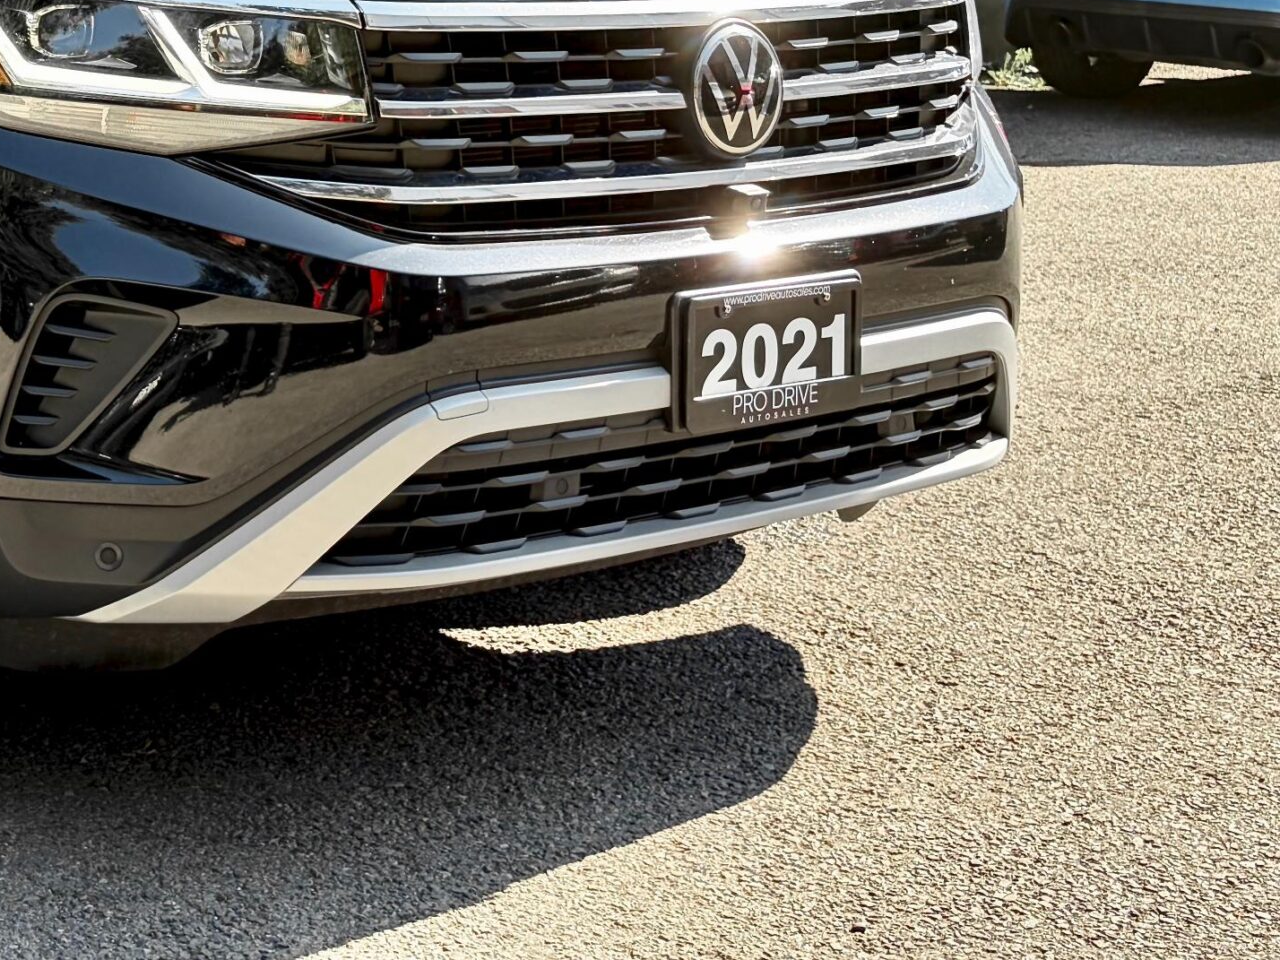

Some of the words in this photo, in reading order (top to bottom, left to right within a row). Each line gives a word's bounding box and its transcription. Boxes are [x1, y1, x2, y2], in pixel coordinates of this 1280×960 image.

[723, 285, 831, 306] www.prodriveautosales.com
[701, 313, 846, 397] 2021
[732, 390, 768, 416] PRO
[772, 383, 819, 409] DRIVE
[740, 406, 810, 424] AUTOSALES
